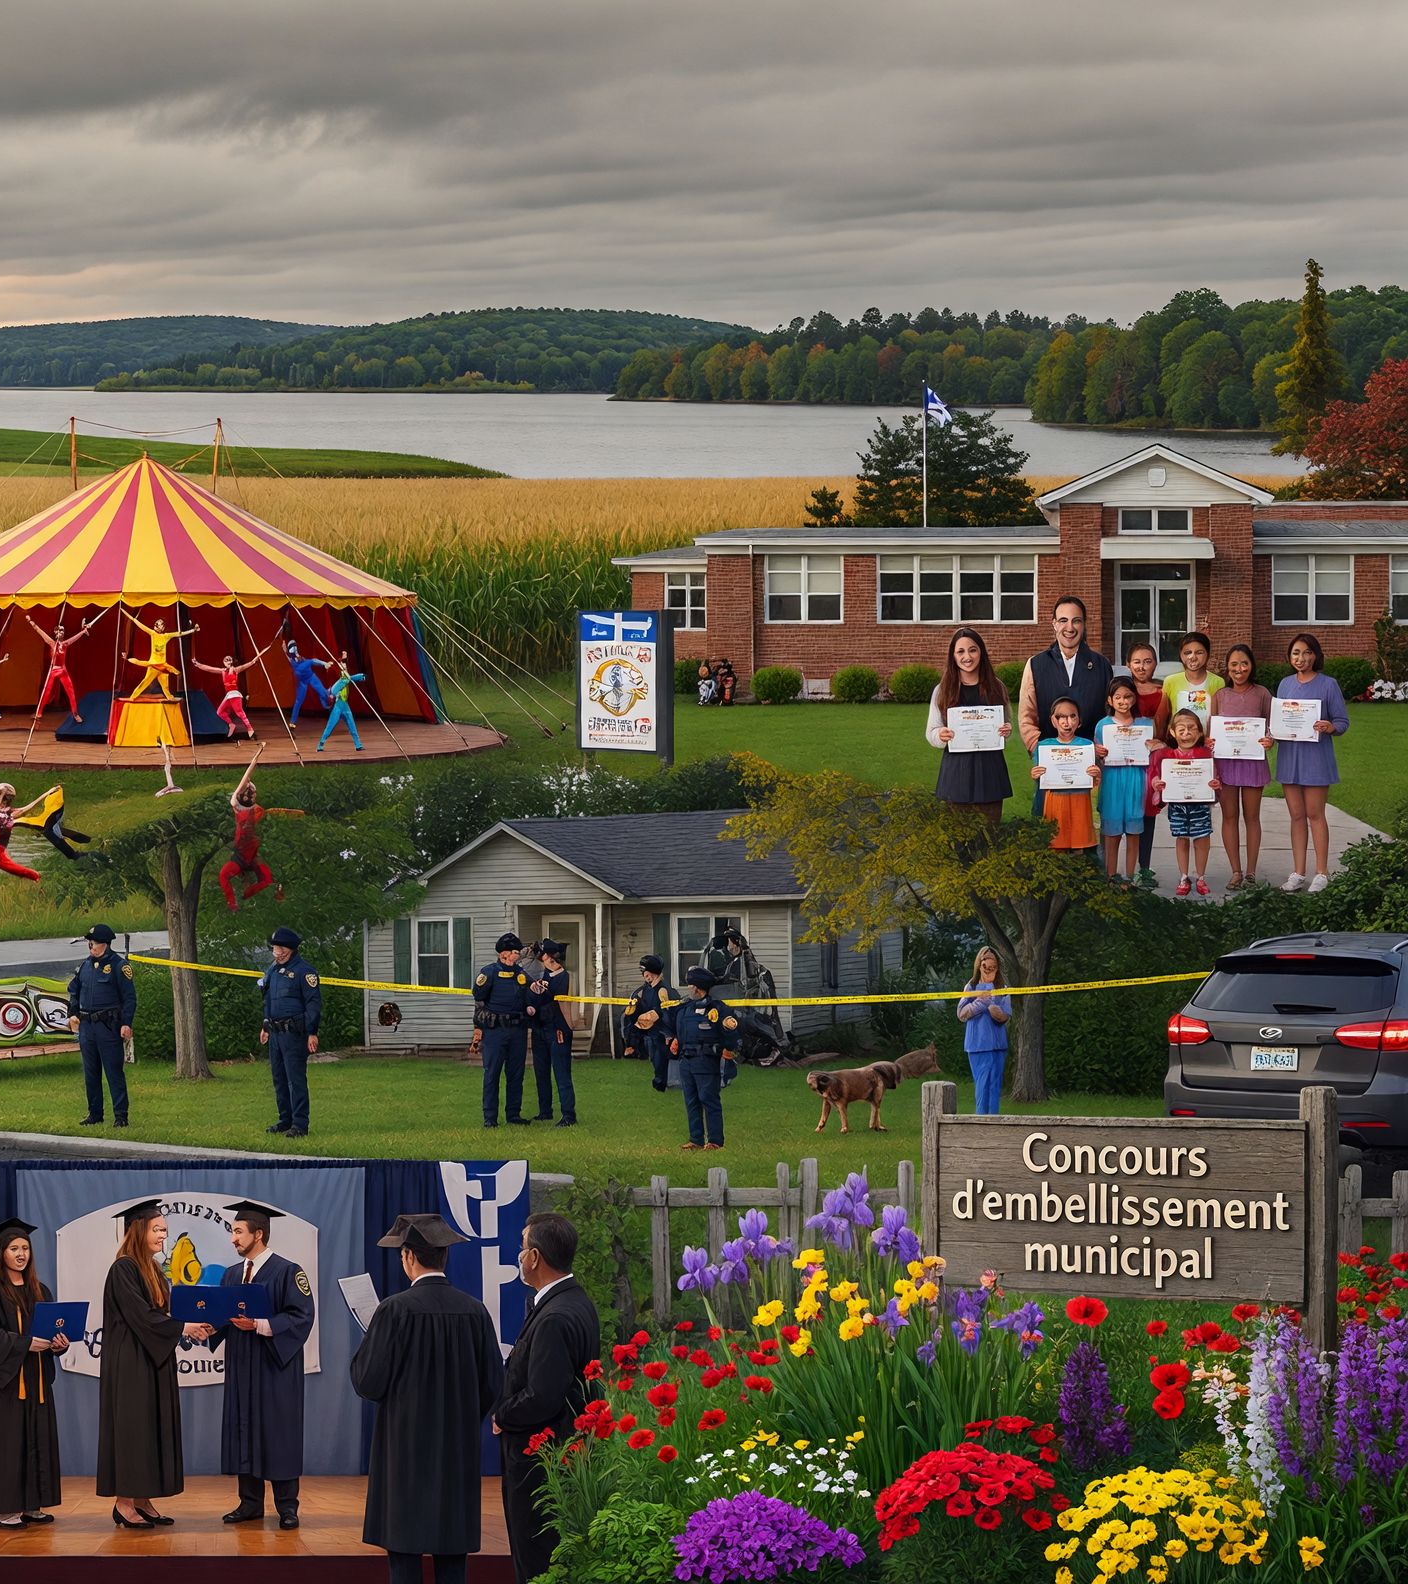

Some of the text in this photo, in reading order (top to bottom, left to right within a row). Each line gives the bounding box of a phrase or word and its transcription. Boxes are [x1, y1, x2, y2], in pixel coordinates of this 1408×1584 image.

[1022, 1132, 1208, 1177] Concours
[952, 1178, 1290, 1231] d'embellissement
[1024, 1235, 1213, 1288] municipal
